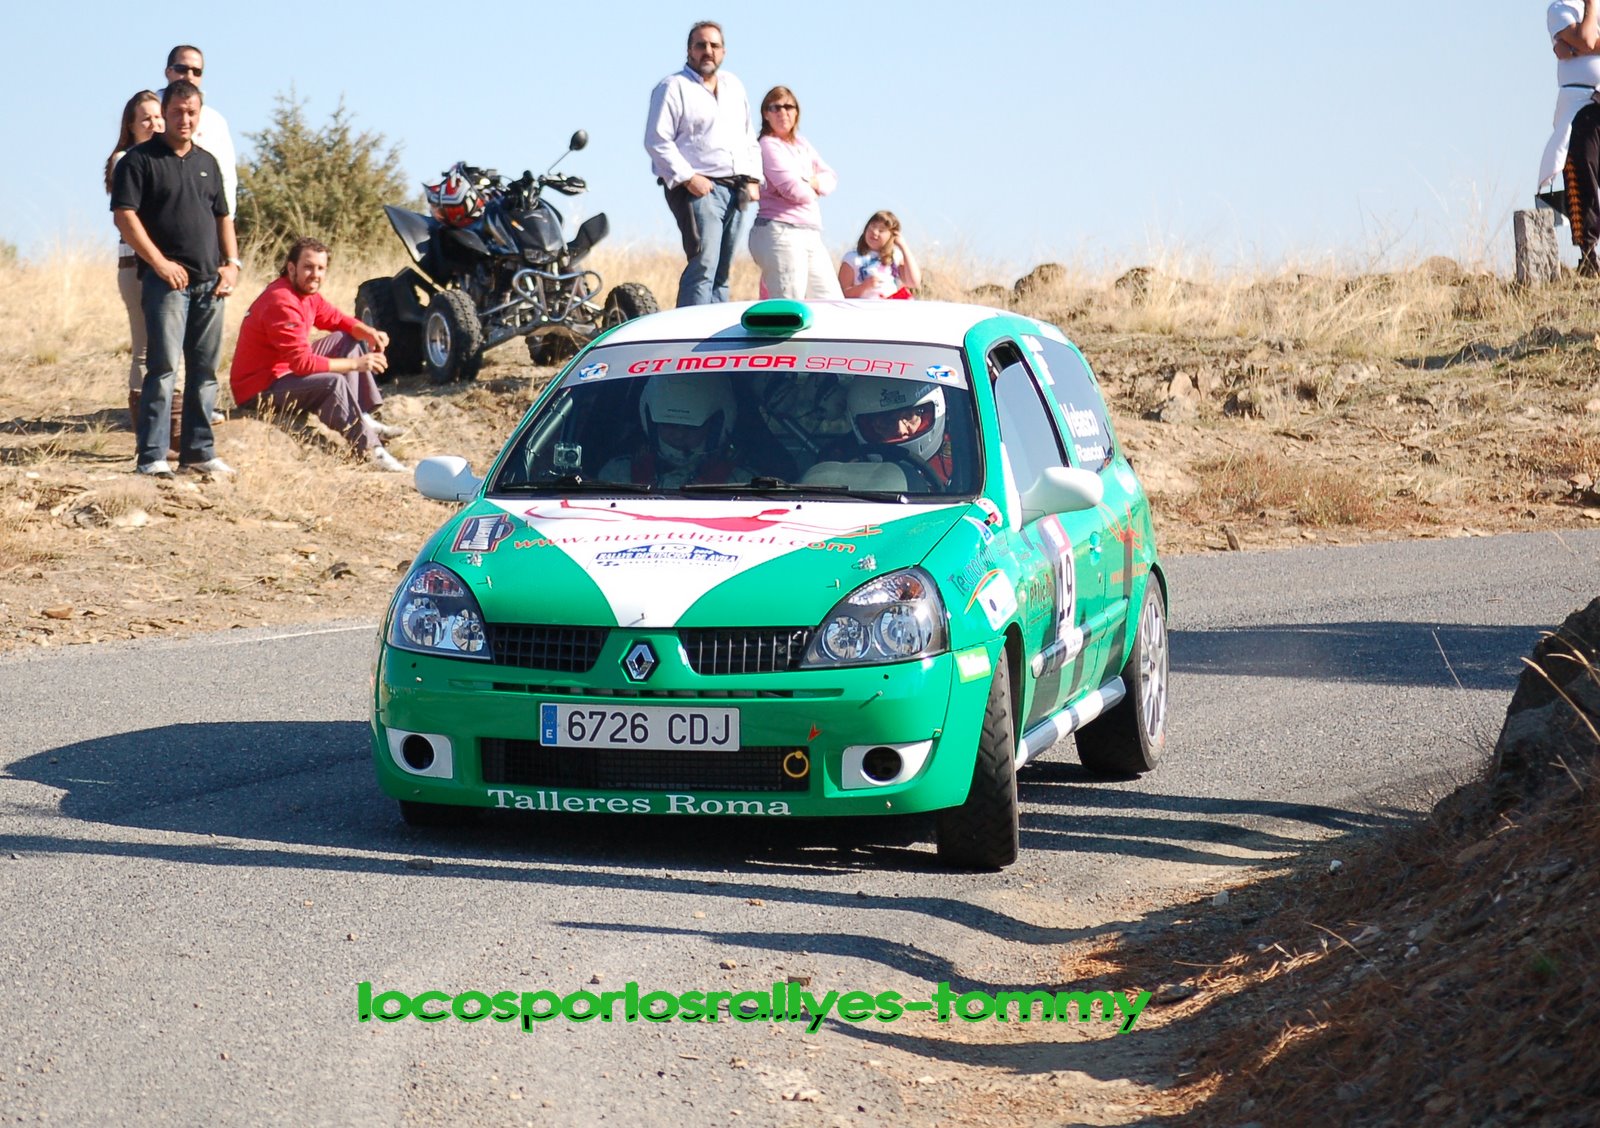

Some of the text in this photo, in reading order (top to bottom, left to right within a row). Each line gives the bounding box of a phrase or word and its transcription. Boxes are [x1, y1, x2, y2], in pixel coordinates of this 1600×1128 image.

[627, 354, 915, 377] GT MOTOR SPORT
[567, 710, 730, 746] 6726 CDJ
[487, 789, 791, 816] Talleres Roma
